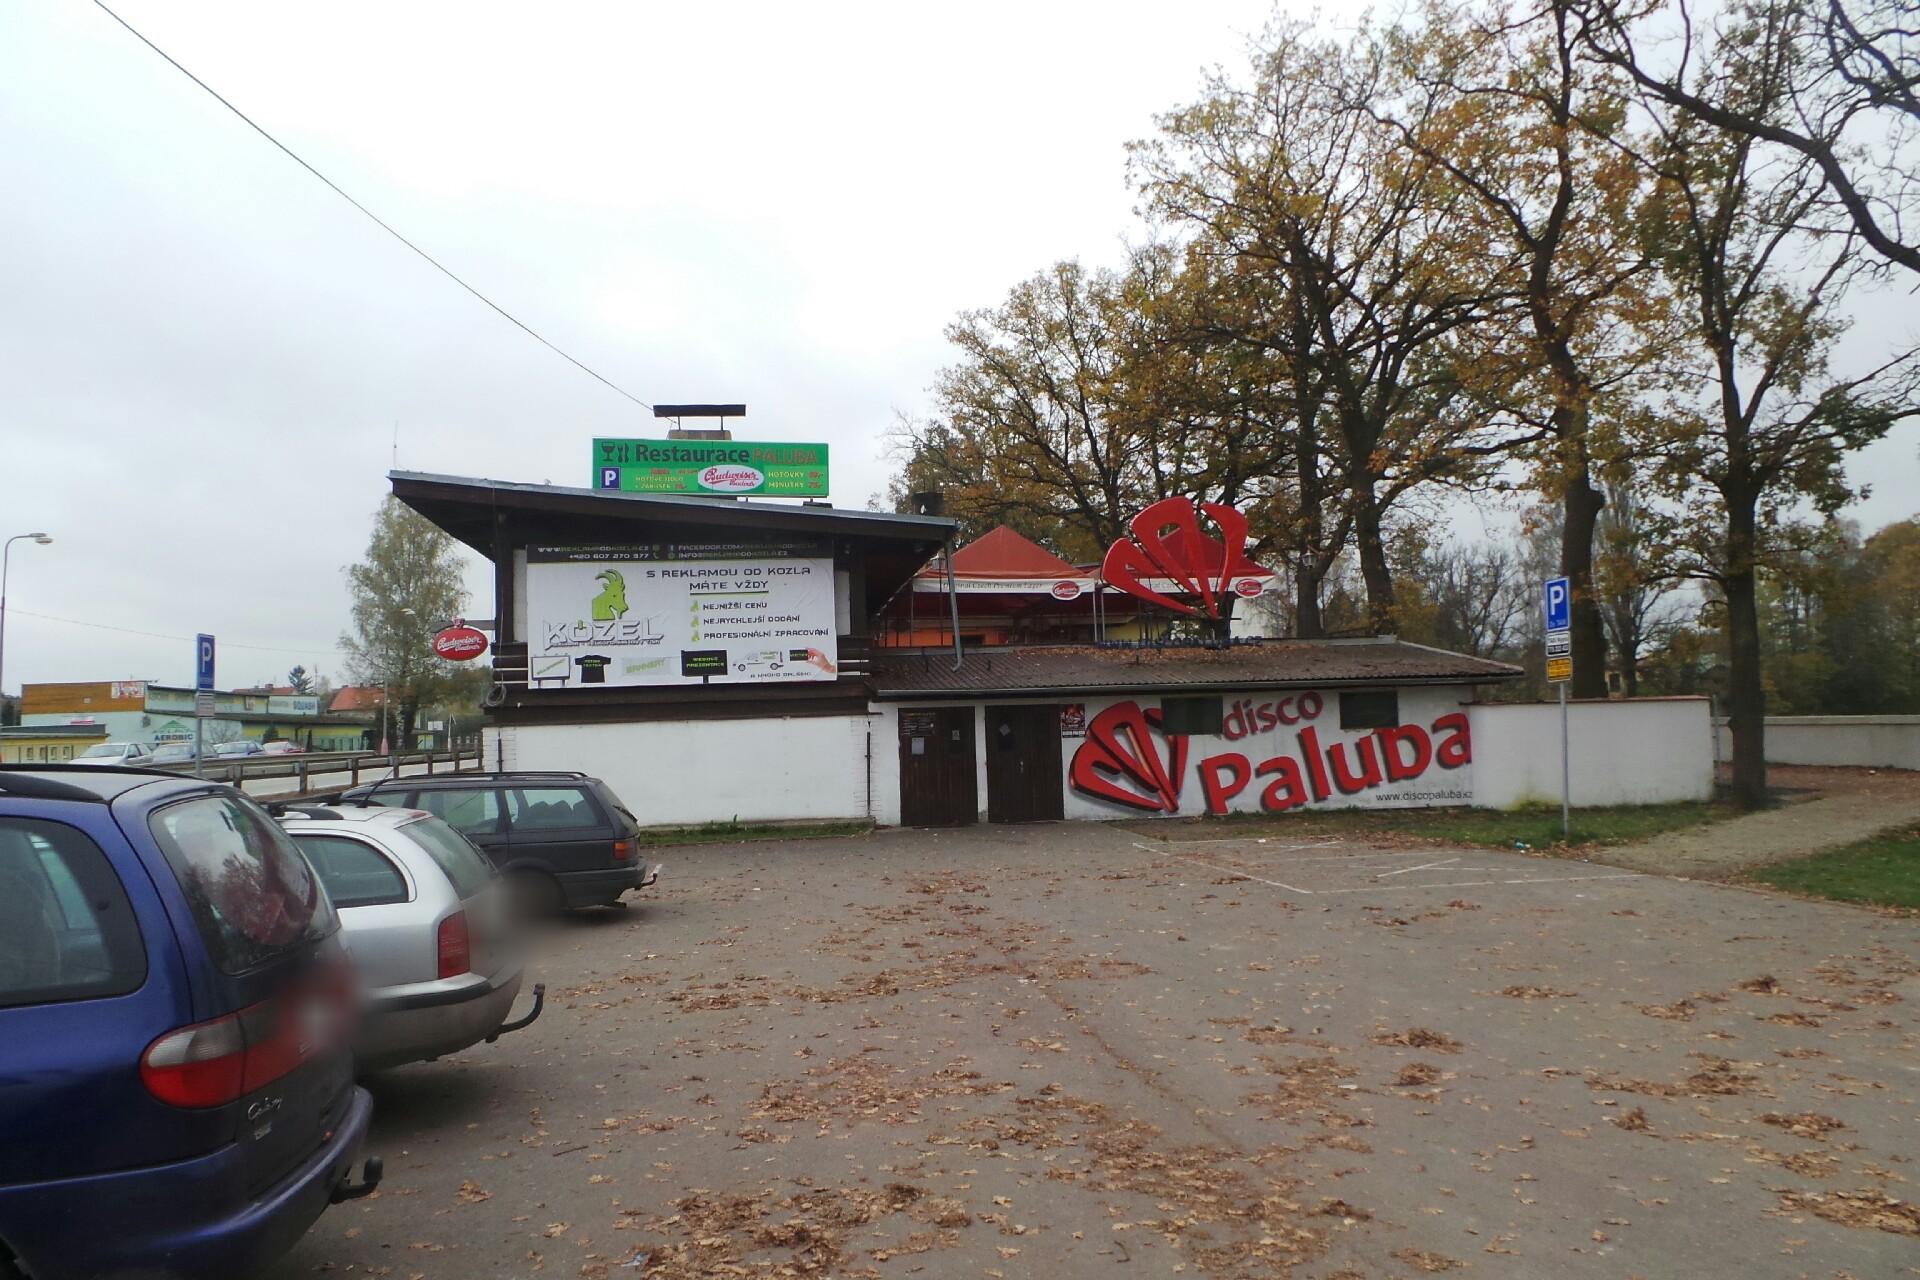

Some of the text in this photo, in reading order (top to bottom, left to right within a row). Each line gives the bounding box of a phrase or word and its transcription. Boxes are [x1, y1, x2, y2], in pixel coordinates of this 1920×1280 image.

[636, 444, 817, 465] Restaurace PALUBA
[604, 470, 616, 486] P
[661, 568, 738, 578] REKLAMOU
[743, 568, 762, 576] OD
[767, 567, 811, 576] KOZLA
[689, 580, 769, 591] MÁTE VŽDY
[543, 618, 664, 651] KOZEL
[1223, 691, 1323, 741] disco
[1198, 712, 1472, 815] Paluba
